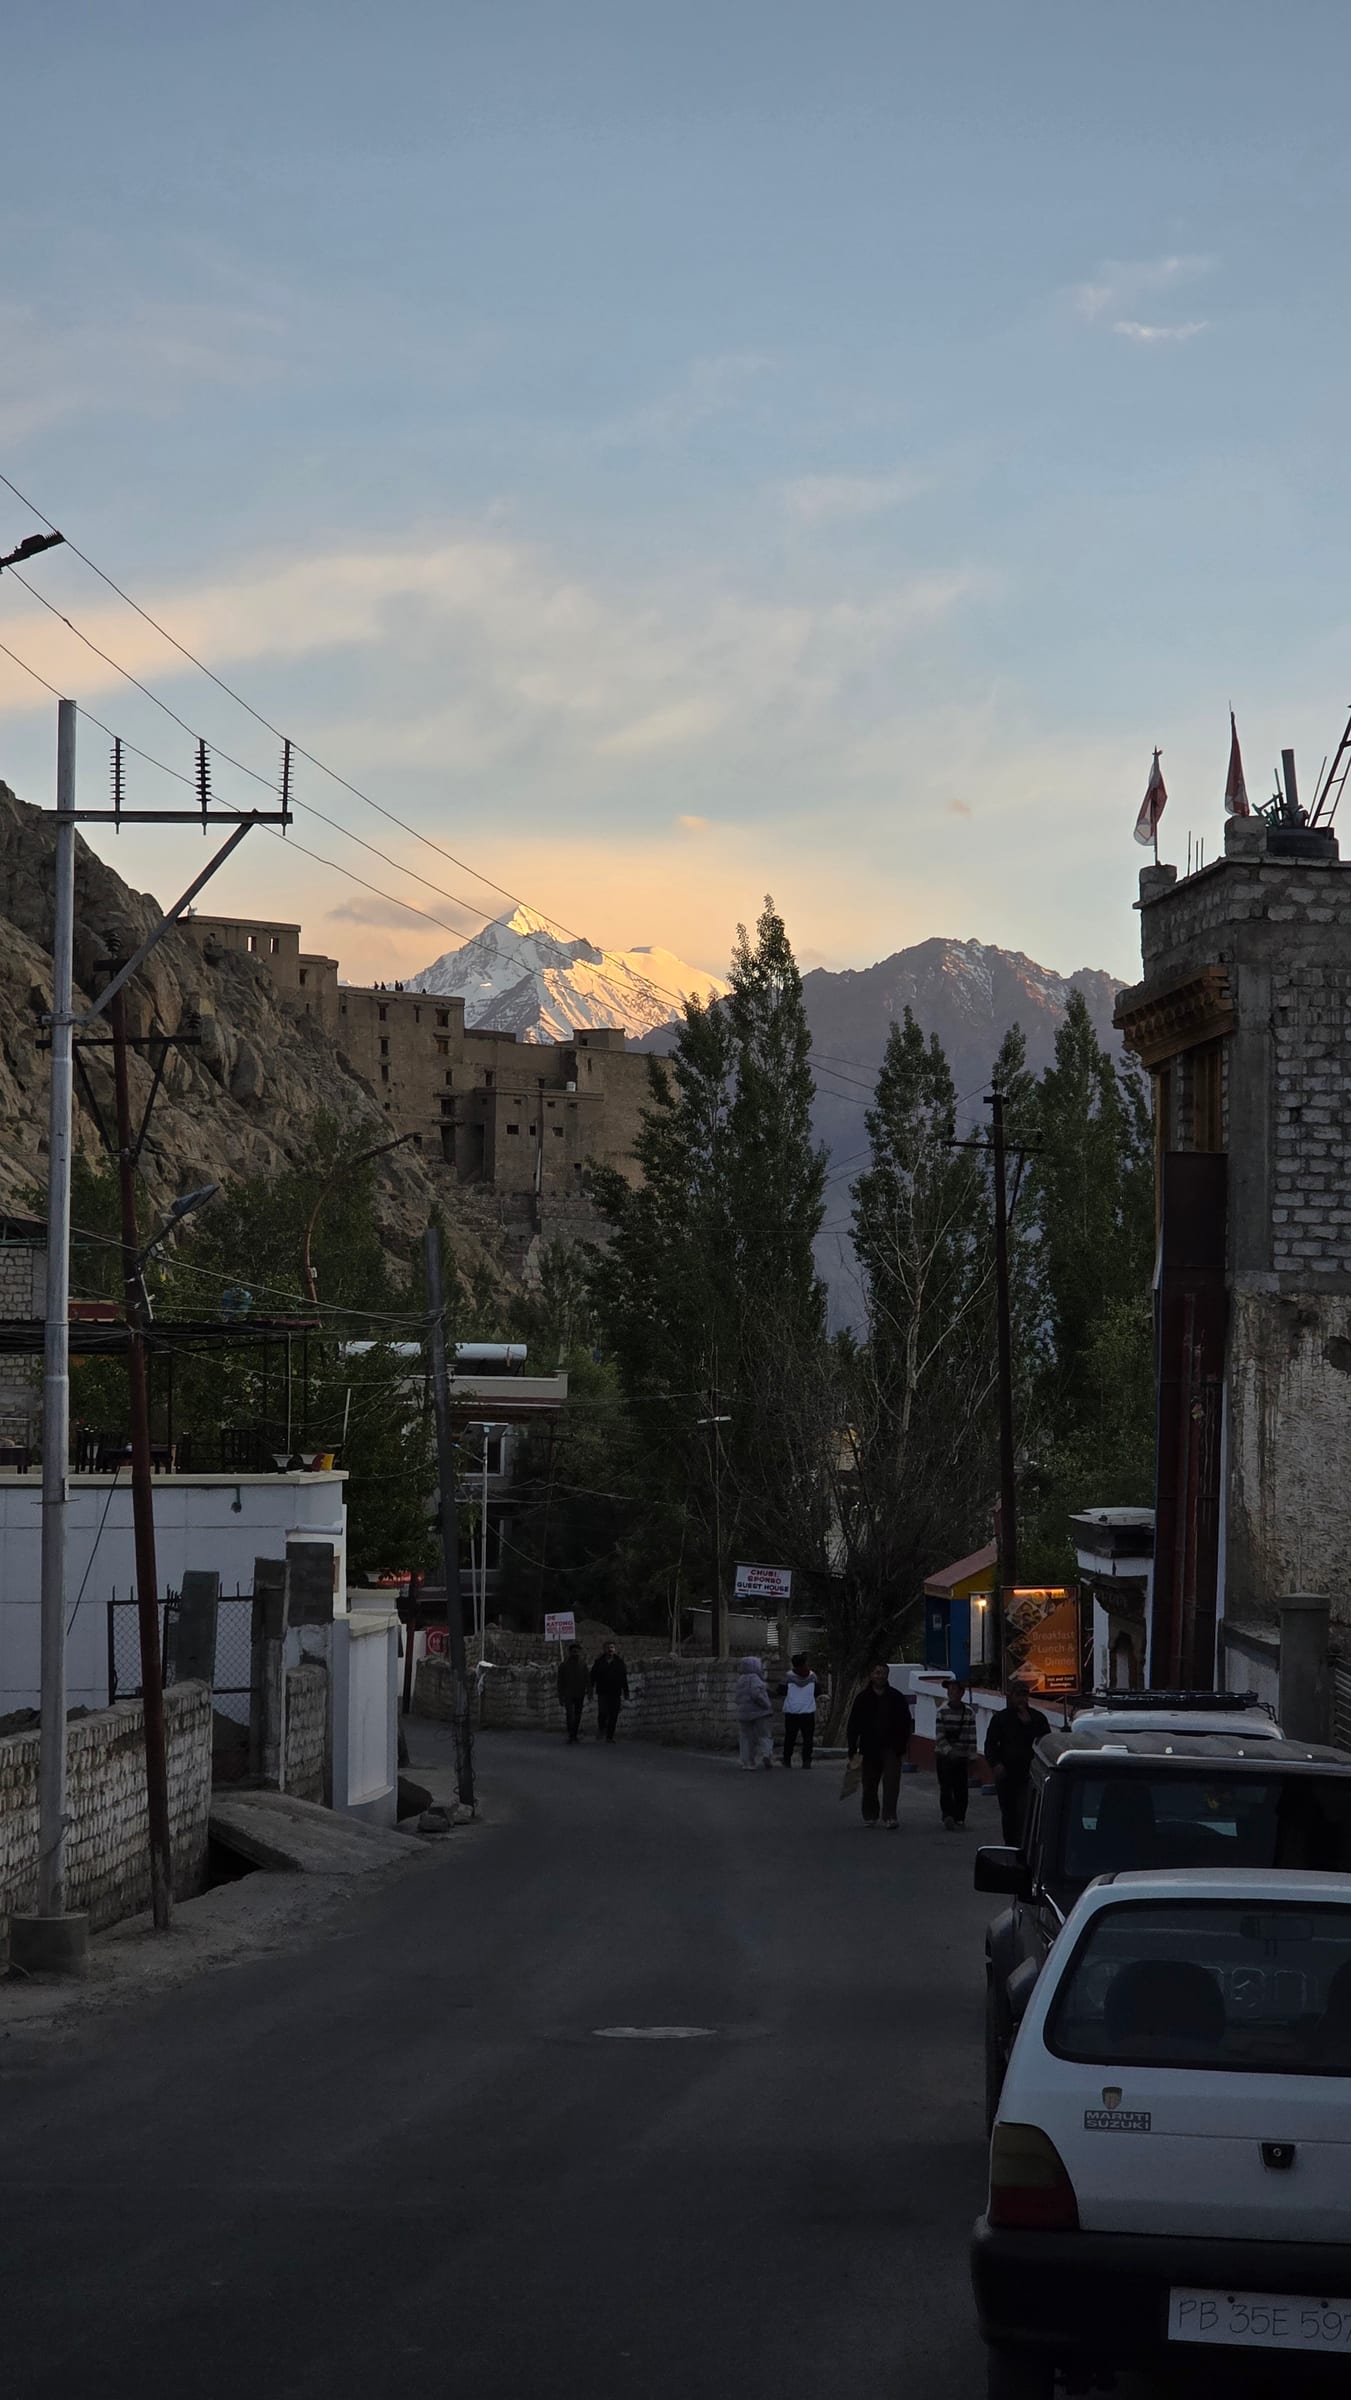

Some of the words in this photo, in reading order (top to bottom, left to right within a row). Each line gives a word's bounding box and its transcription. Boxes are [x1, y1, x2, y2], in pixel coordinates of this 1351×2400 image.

[751, 1569, 777, 1577] CHUBI
[737, 1581, 762, 1589] GUEST
[764, 1584, 788, 1592] HOUSE
[1032, 1631, 1075, 1641] Breakfast
[1037, 1643, 1065, 1653] Lunch
[1045, 1656, 1075, 1666] Dinner
[1087, 2111, 1149, 2121] MARUTI
[1087, 2120, 1149, 2129] SUZUKI
[1179, 2300, 1219, 2330] PB
[1229, 2304, 1289, 2336] 35E
